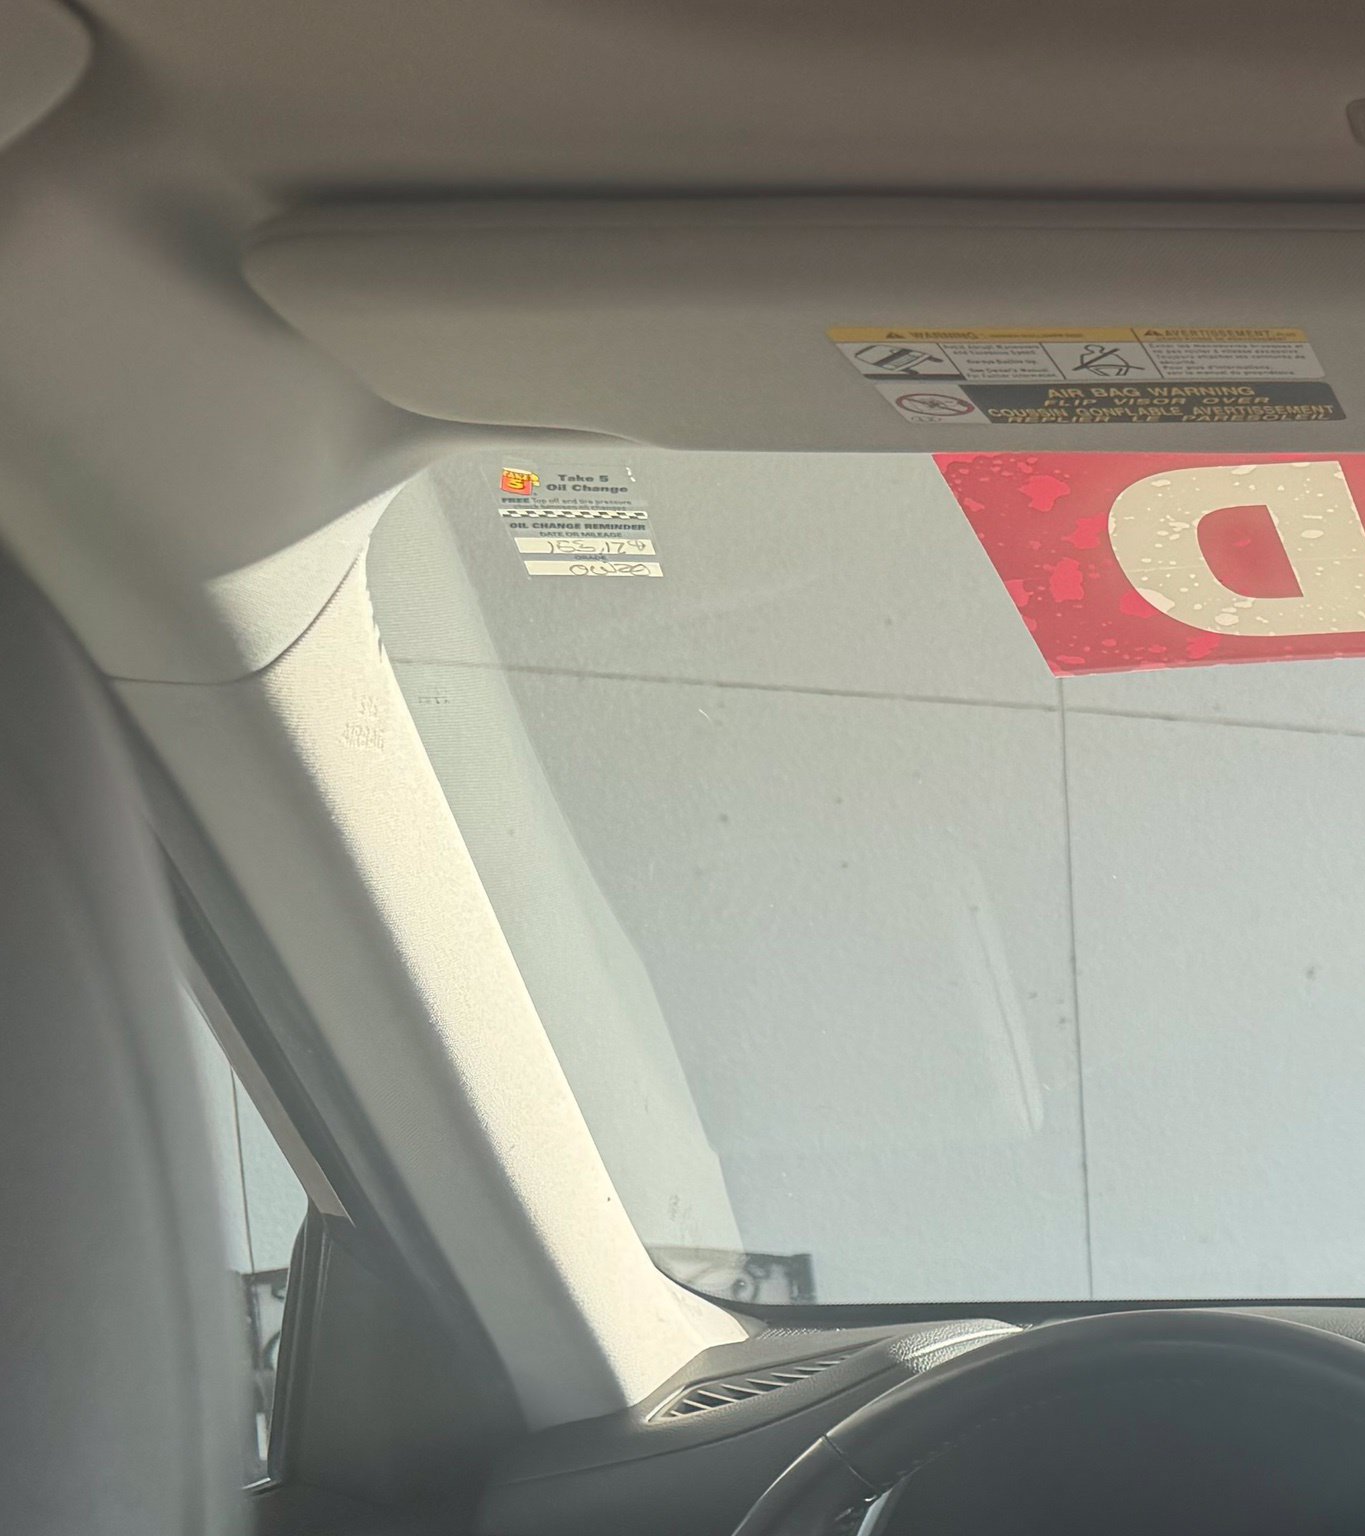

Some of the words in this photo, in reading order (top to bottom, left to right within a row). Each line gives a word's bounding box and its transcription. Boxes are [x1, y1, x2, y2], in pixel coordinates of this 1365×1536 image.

[1047, 388, 1084, 399] AIR
[1090, 387, 1140, 398] BAG
[1147, 386, 1255, 397] WARNING
[1043, 398, 1098, 407] FLIP
[1113, 398, 1187, 406] VISOR
[1202, 397, 1270, 405] OVER
[987, 407, 1068, 418] COUSSIN
[1075, 406, 1183, 417] GONFLABLE
[1193, 405, 1336, 416] AVERTISSEMENT
[558, 474, 594, 483] Take
[598, 474, 609, 483] 5
[545, 483, 570, 492] Oil
[572, 484, 629, 494] Change
[509, 522, 529, 530] OIL
[532, 522, 582, 531] CHANGE
[584, 523, 647, 531] REMINDER
